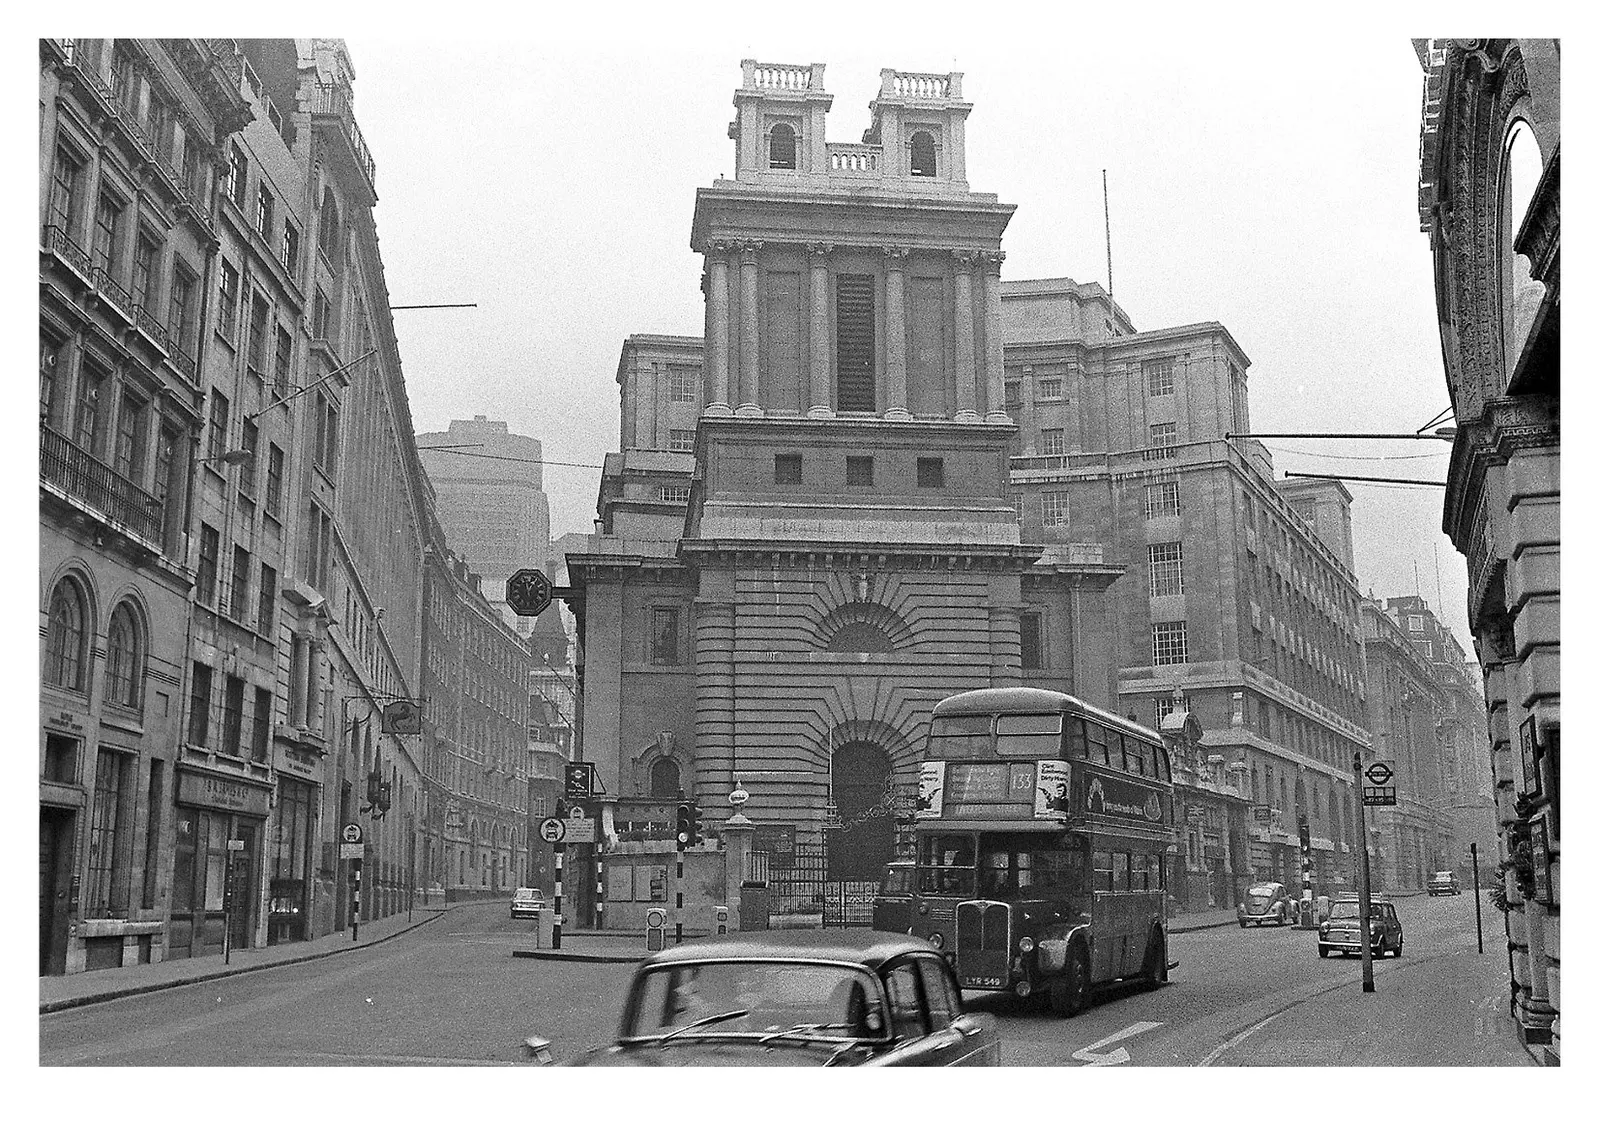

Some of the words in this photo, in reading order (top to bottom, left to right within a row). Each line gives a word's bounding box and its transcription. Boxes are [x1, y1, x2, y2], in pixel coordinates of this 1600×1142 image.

[1013, 773, 1031, 789] 133
[966, 977, 982, 986] LYR
[984, 977, 1001, 986] 549
